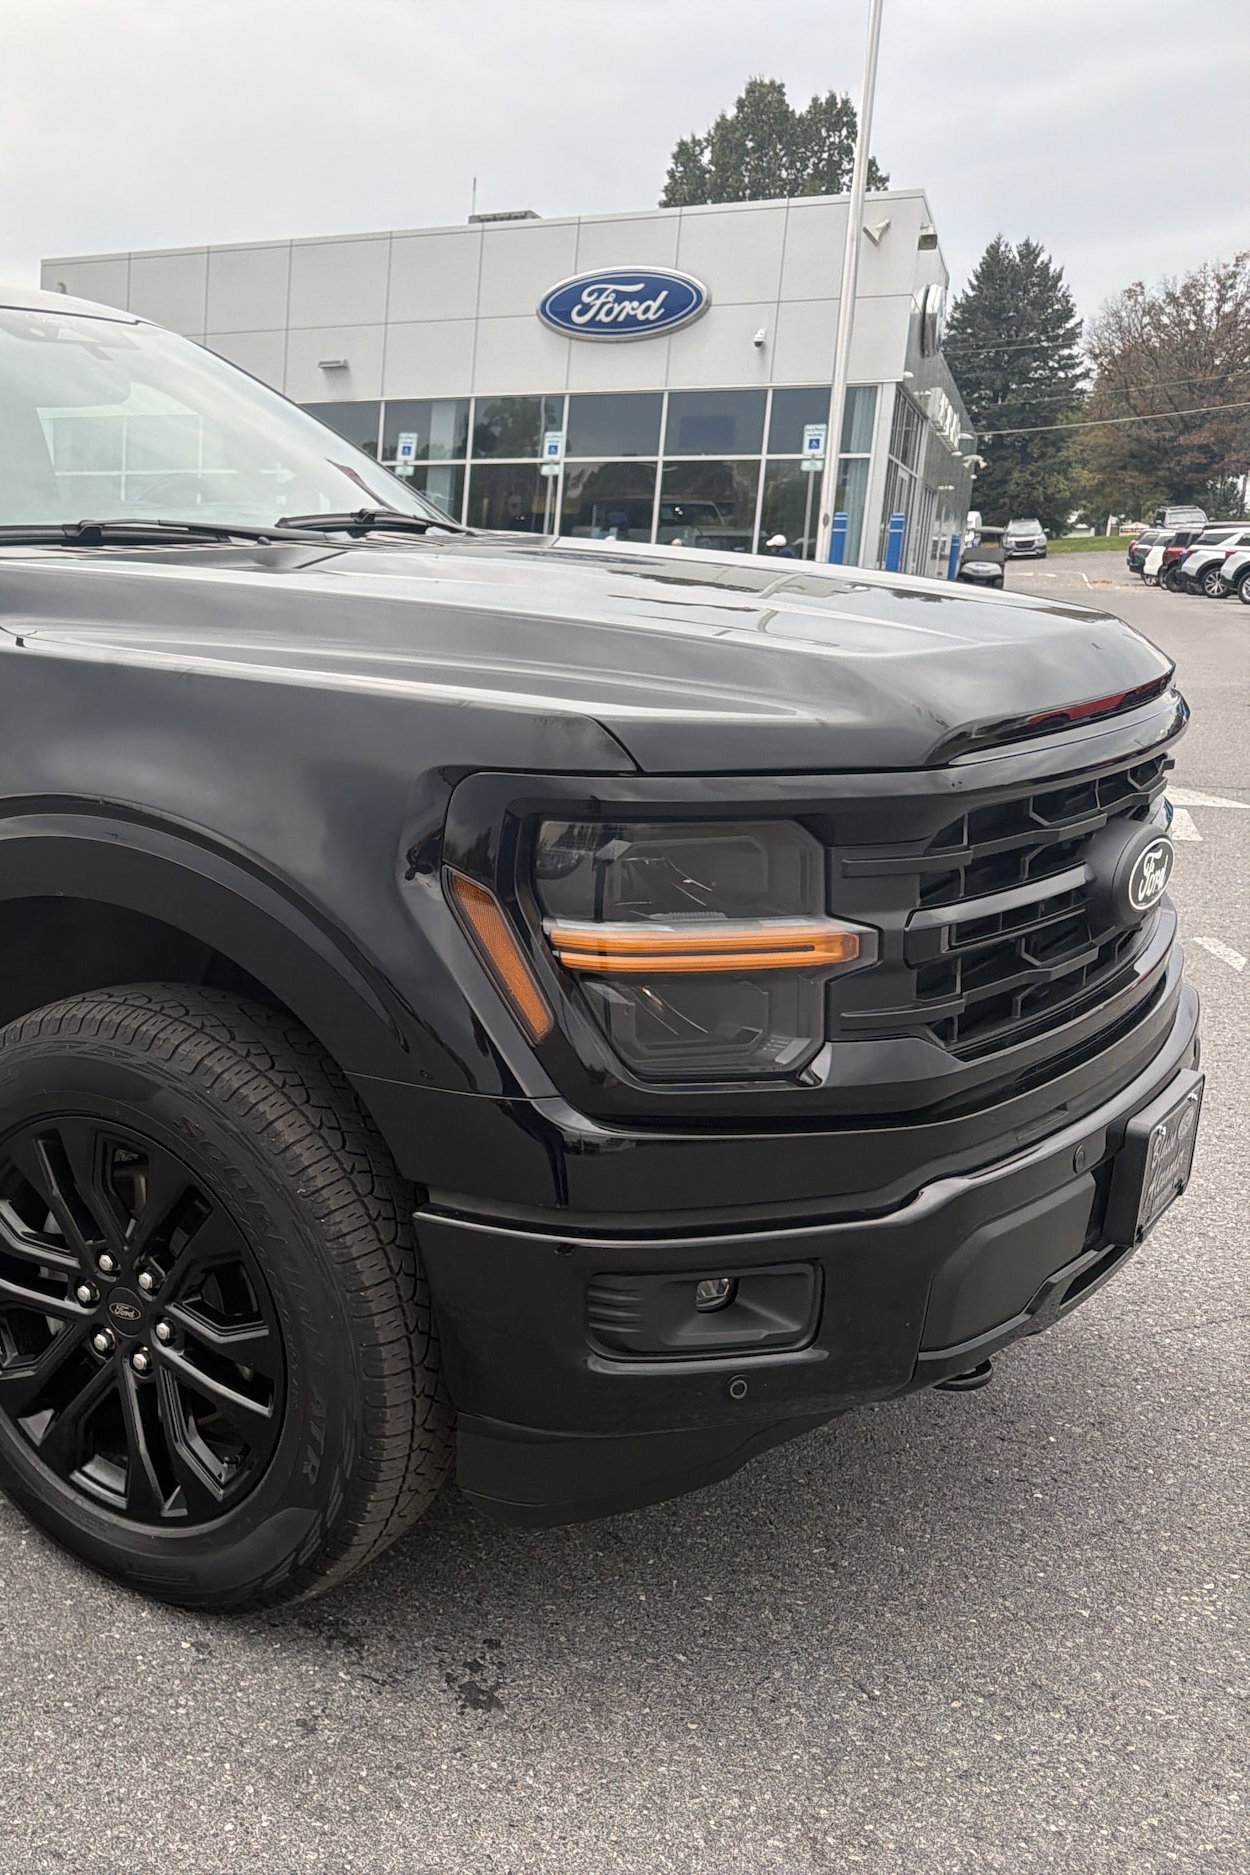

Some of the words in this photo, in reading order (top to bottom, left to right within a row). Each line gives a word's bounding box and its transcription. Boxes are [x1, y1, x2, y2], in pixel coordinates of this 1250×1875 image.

[570, 282, 670, 325] Ford
[1137, 848, 1169, 902] Ford
[114, 1303, 136, 1319] Ford
